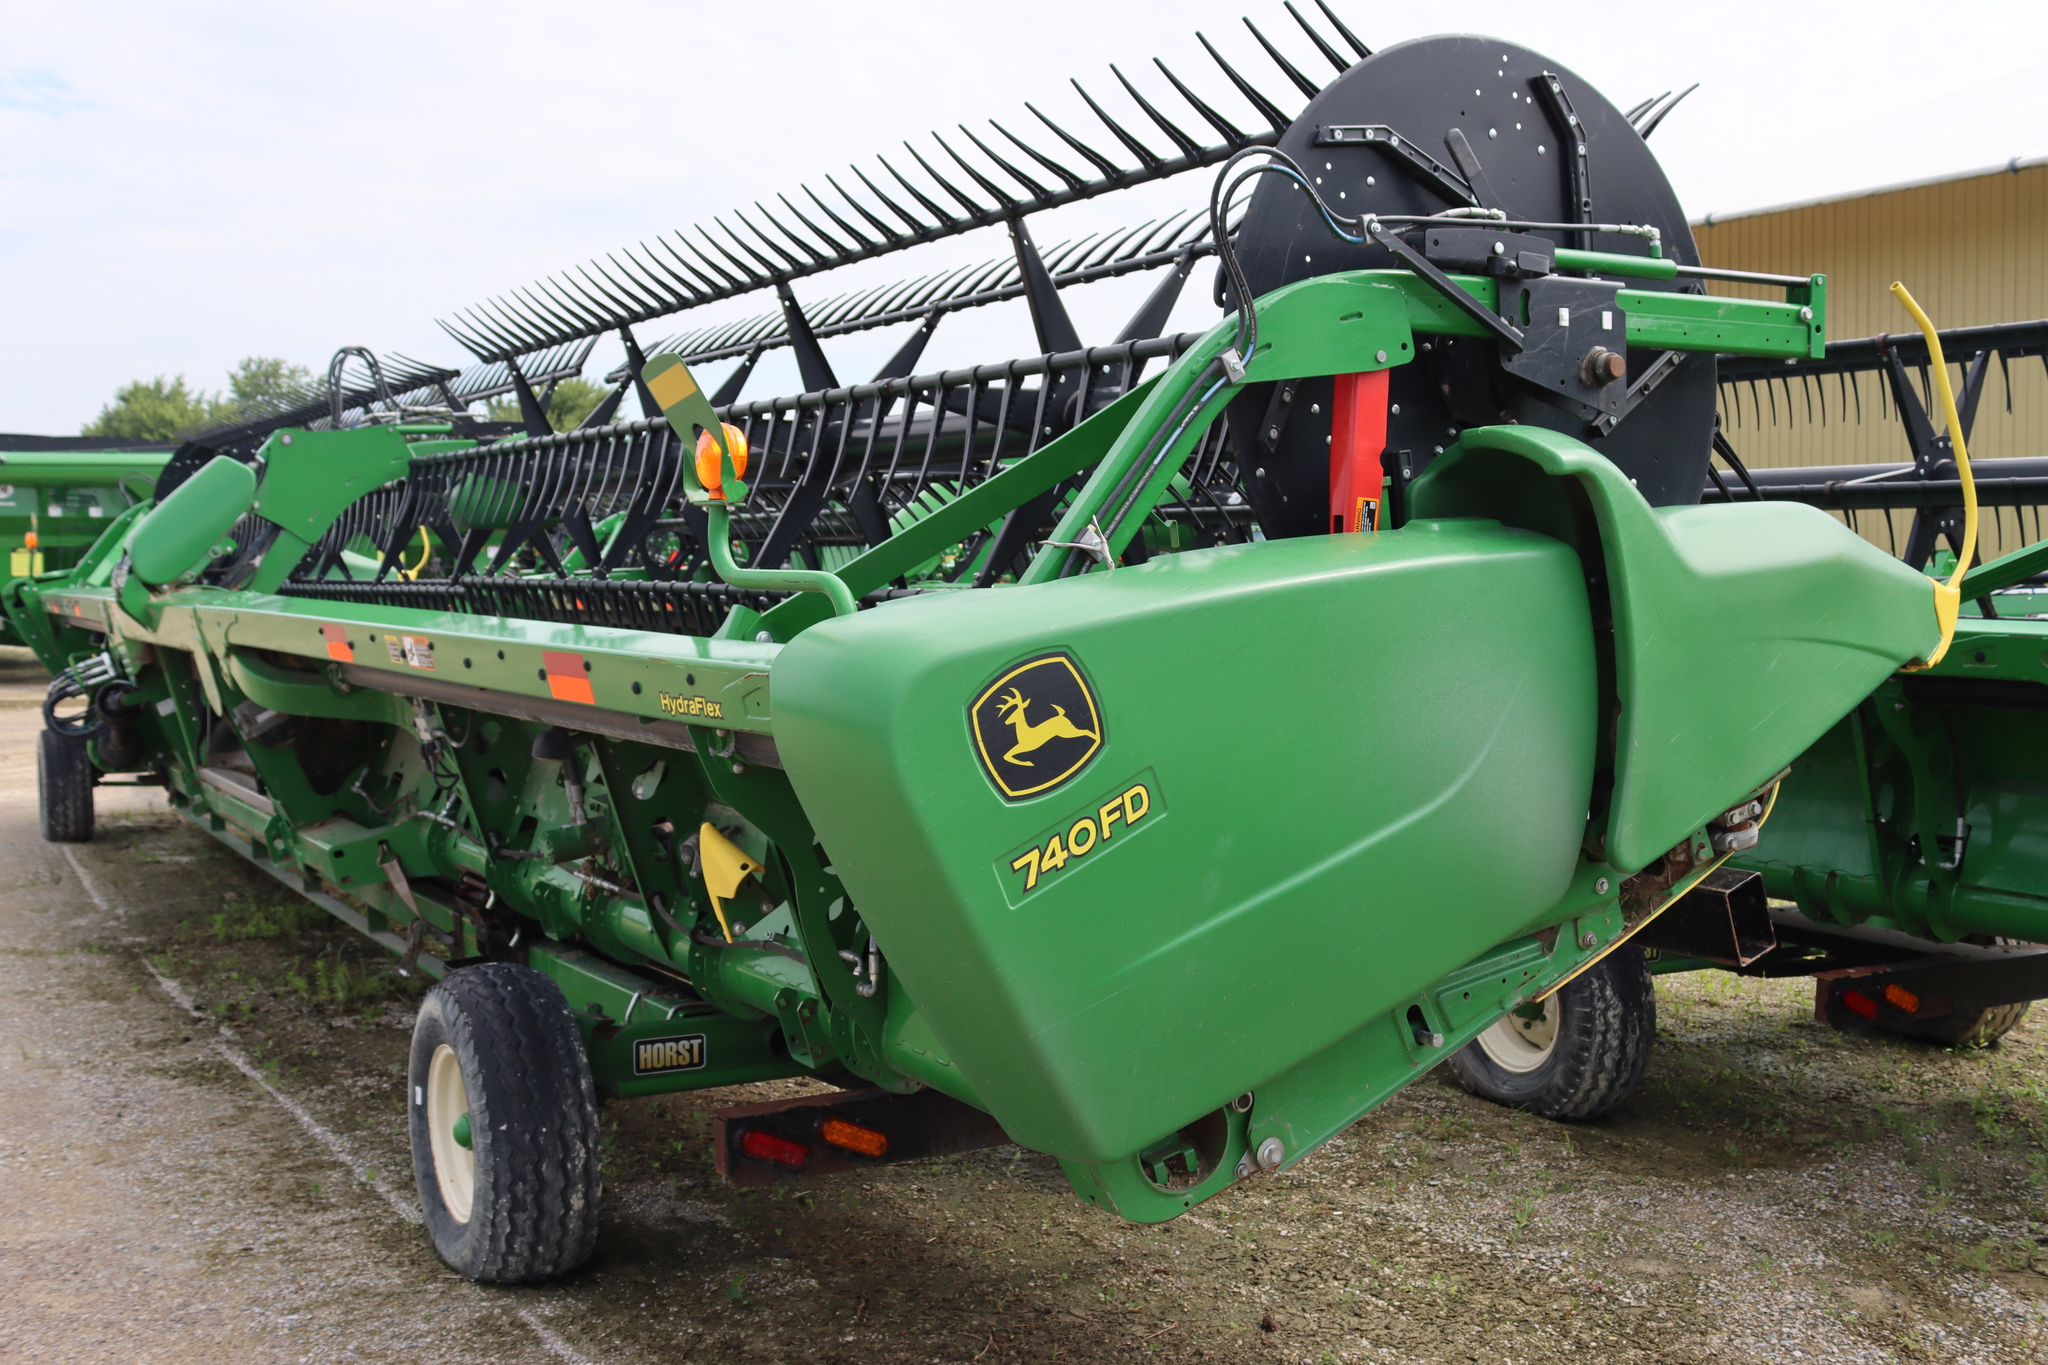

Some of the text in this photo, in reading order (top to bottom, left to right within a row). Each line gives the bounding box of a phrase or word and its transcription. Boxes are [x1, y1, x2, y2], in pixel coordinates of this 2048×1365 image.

[659, 691, 724, 720] HydraFlex
[1009, 783, 1151, 895] 740FD
[639, 1039, 702, 1070] HORST
